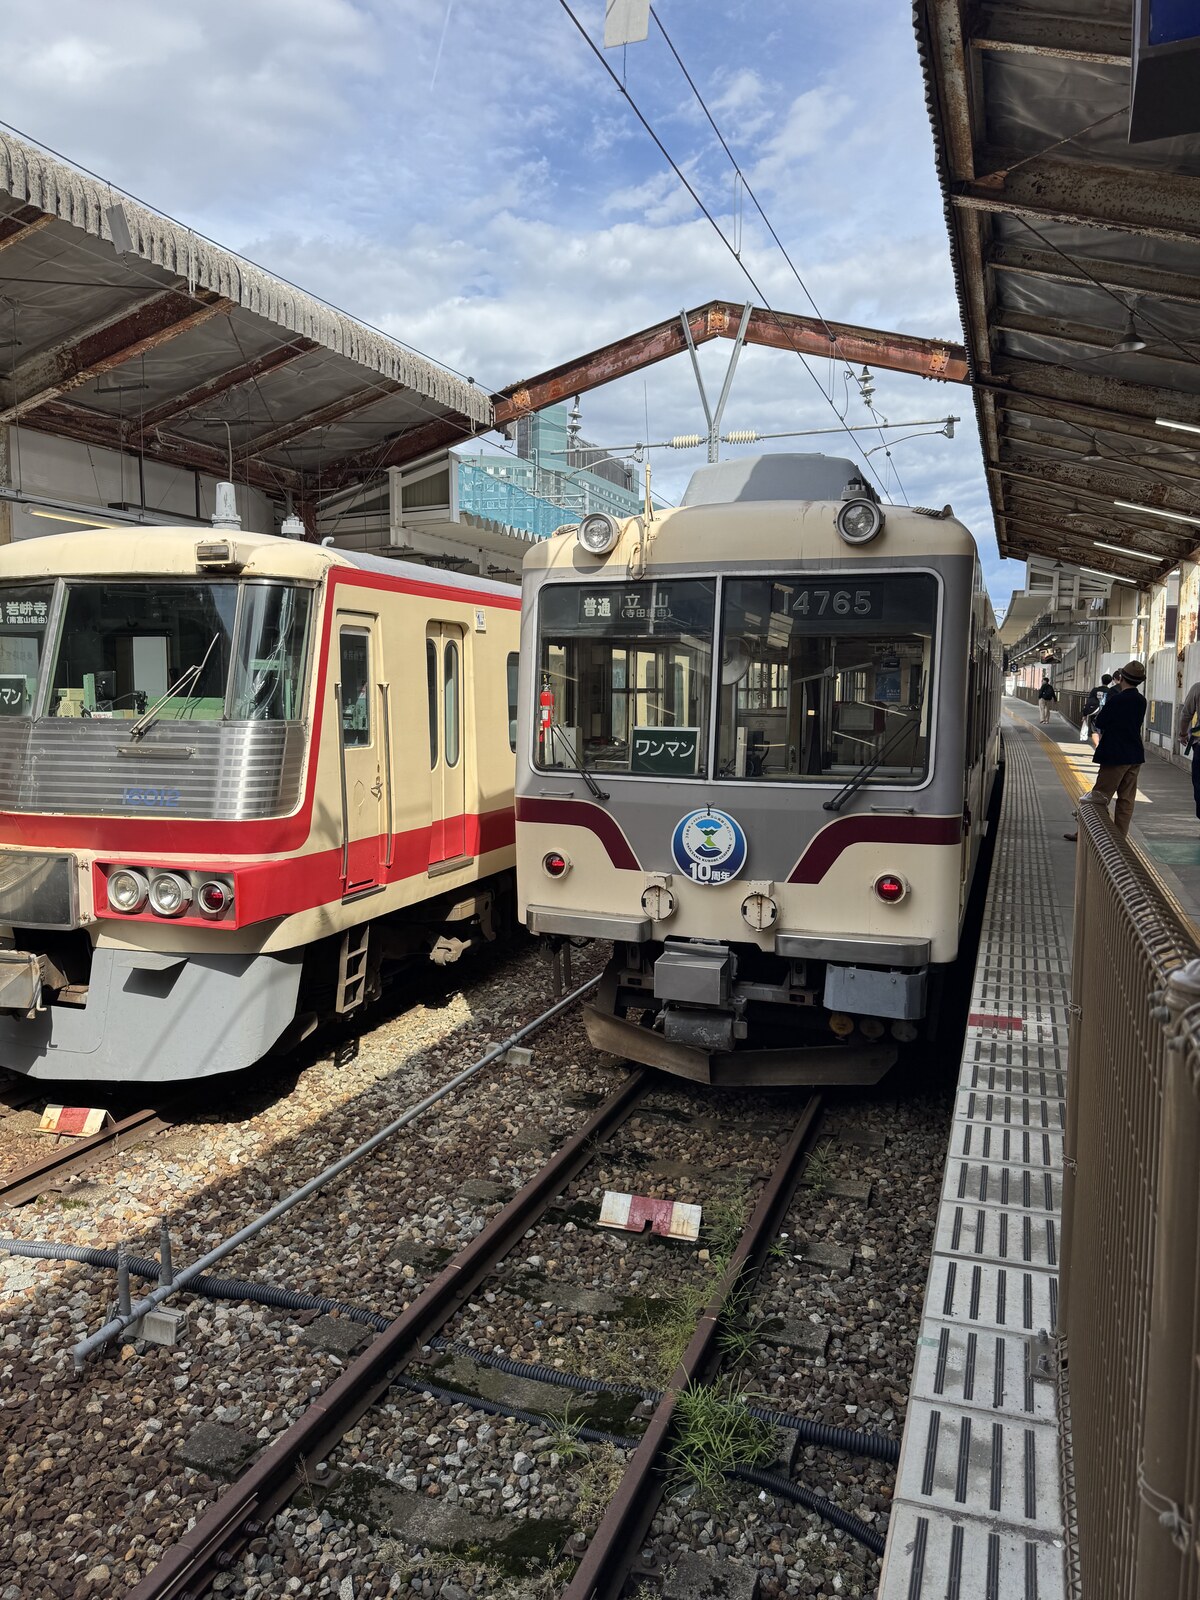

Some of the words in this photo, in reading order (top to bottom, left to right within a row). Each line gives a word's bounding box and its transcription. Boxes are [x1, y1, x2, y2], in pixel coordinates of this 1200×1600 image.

[583, 597, 612, 617] 普通
[783, 590, 872, 615] 14765
[0, 688, 21, 705] マン
[636, 739, 694, 758] ワンマン
[690, 862, 731, 881] 10周年
